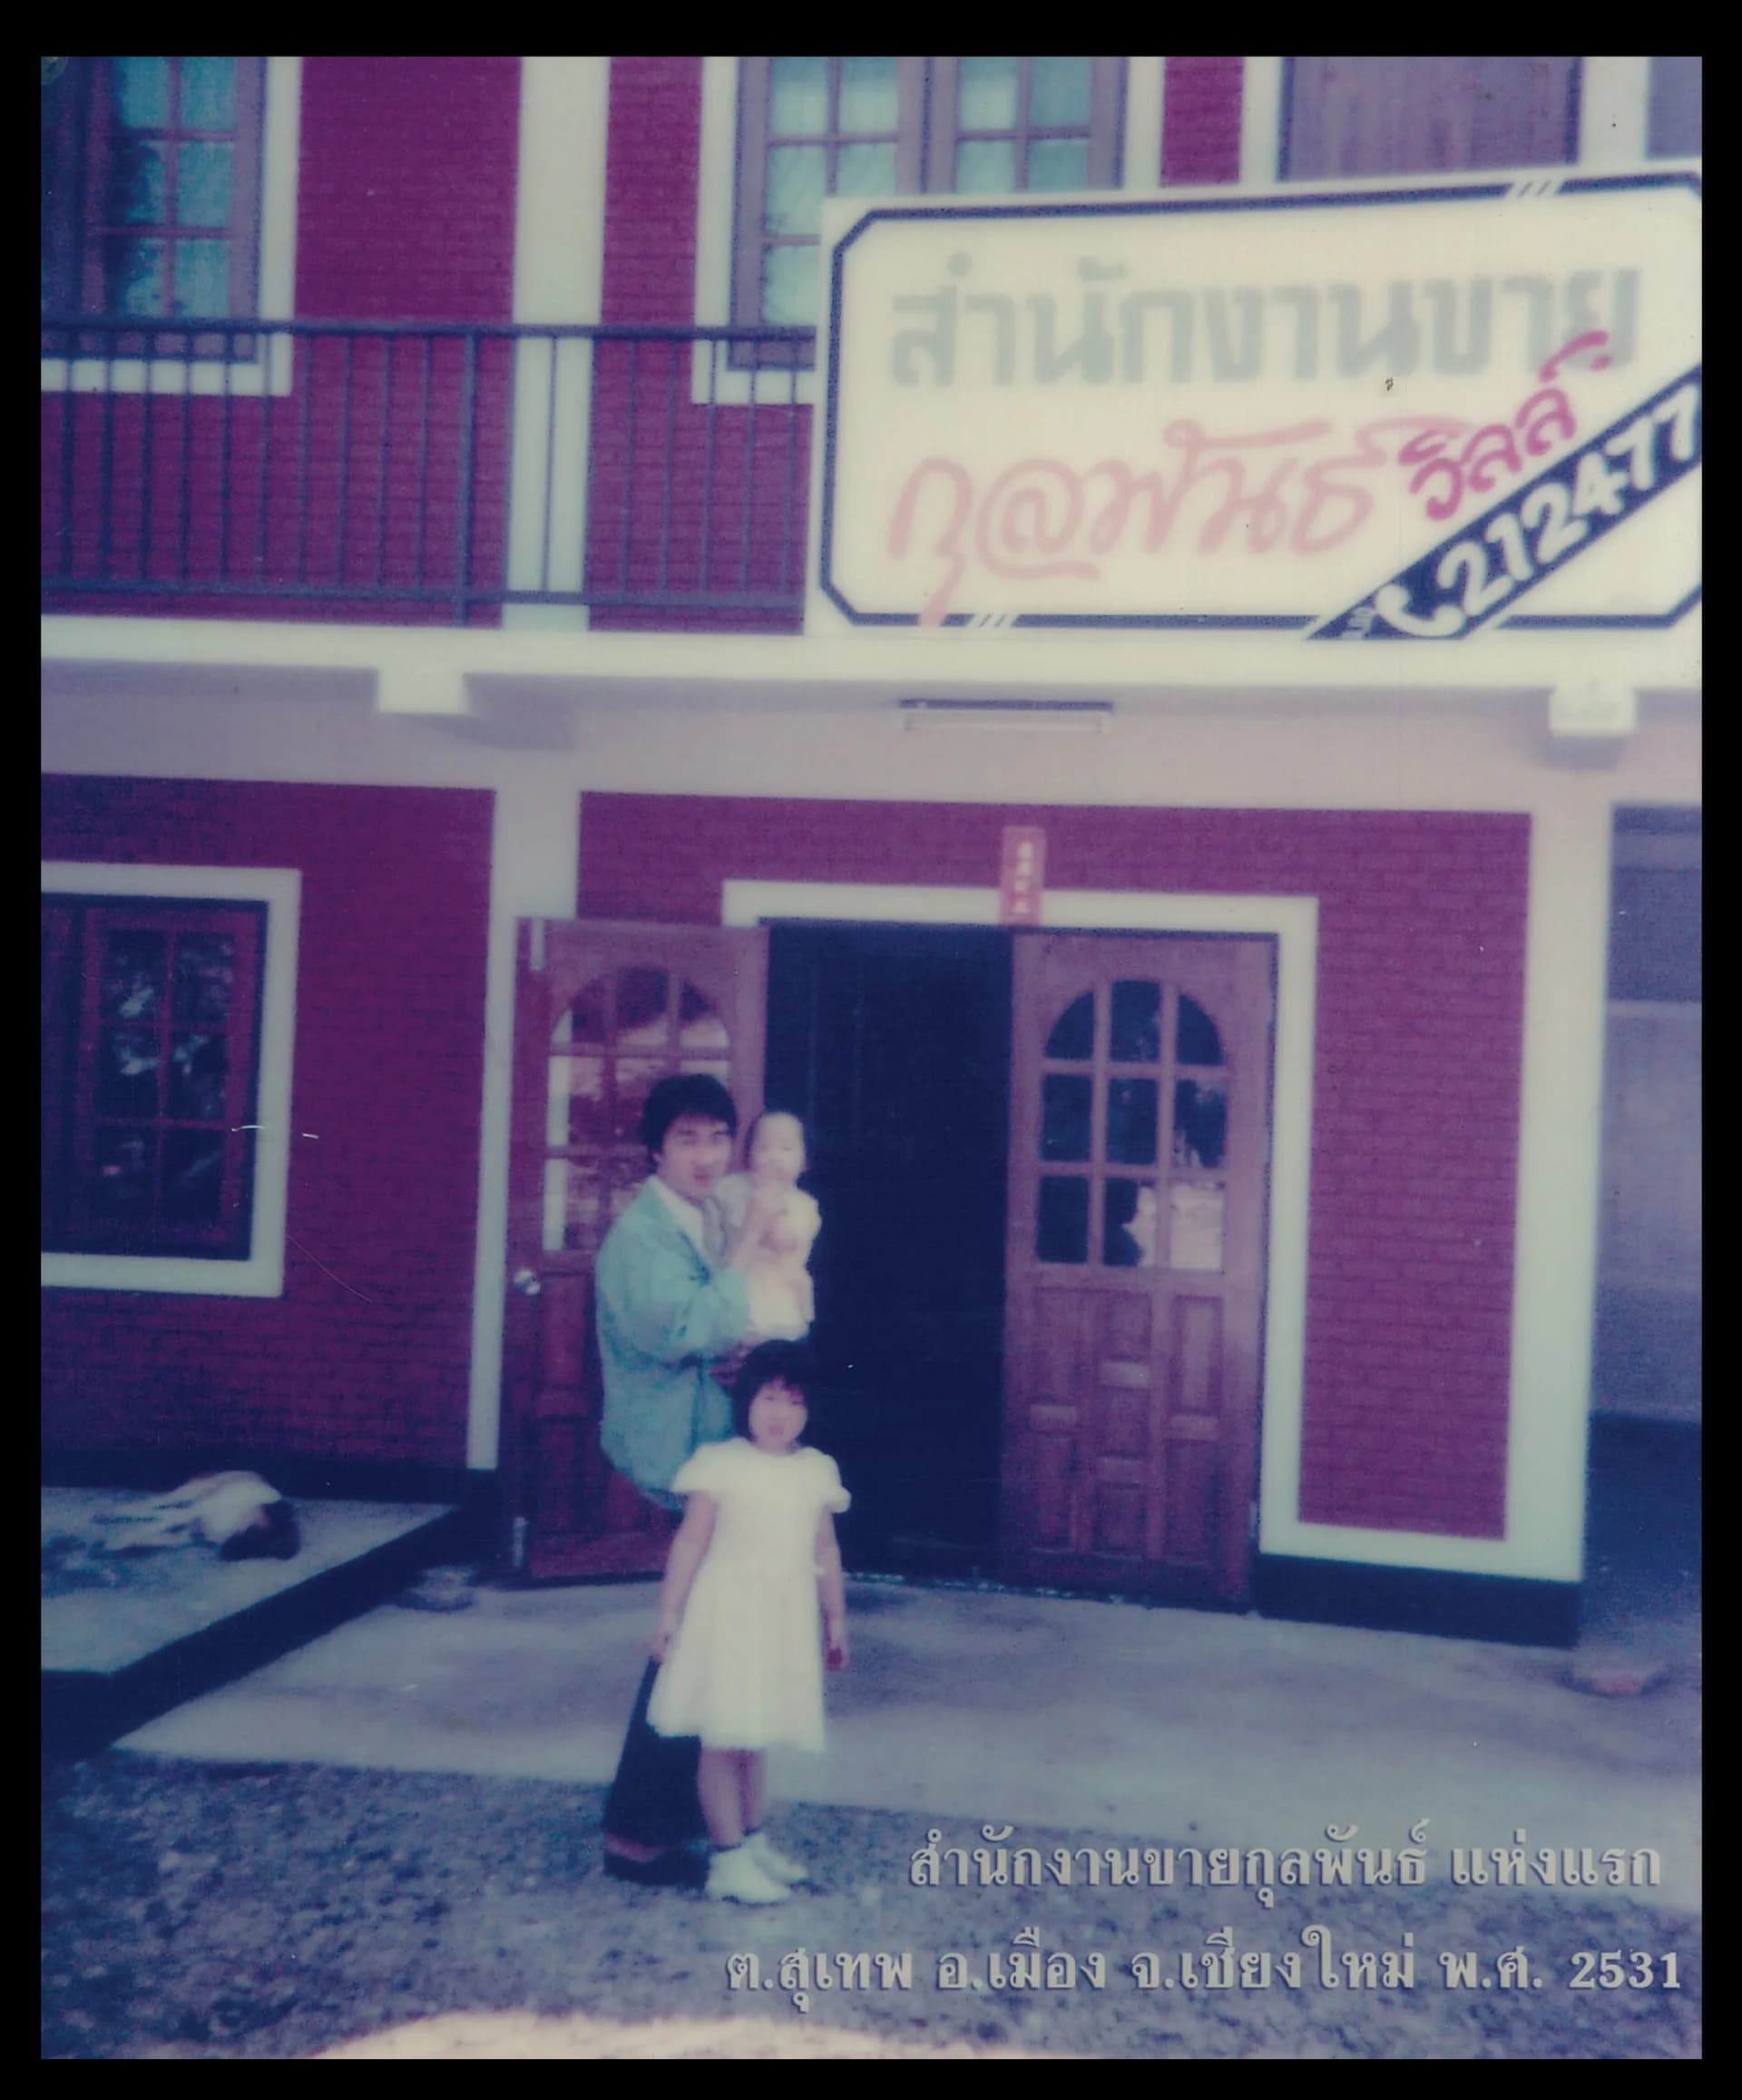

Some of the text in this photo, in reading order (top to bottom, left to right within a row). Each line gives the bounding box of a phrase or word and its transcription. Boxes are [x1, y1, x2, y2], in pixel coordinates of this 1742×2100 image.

[890, 251, 1641, 388] สำนักงานขาย
[1437, 384, 1701, 616] 212477
